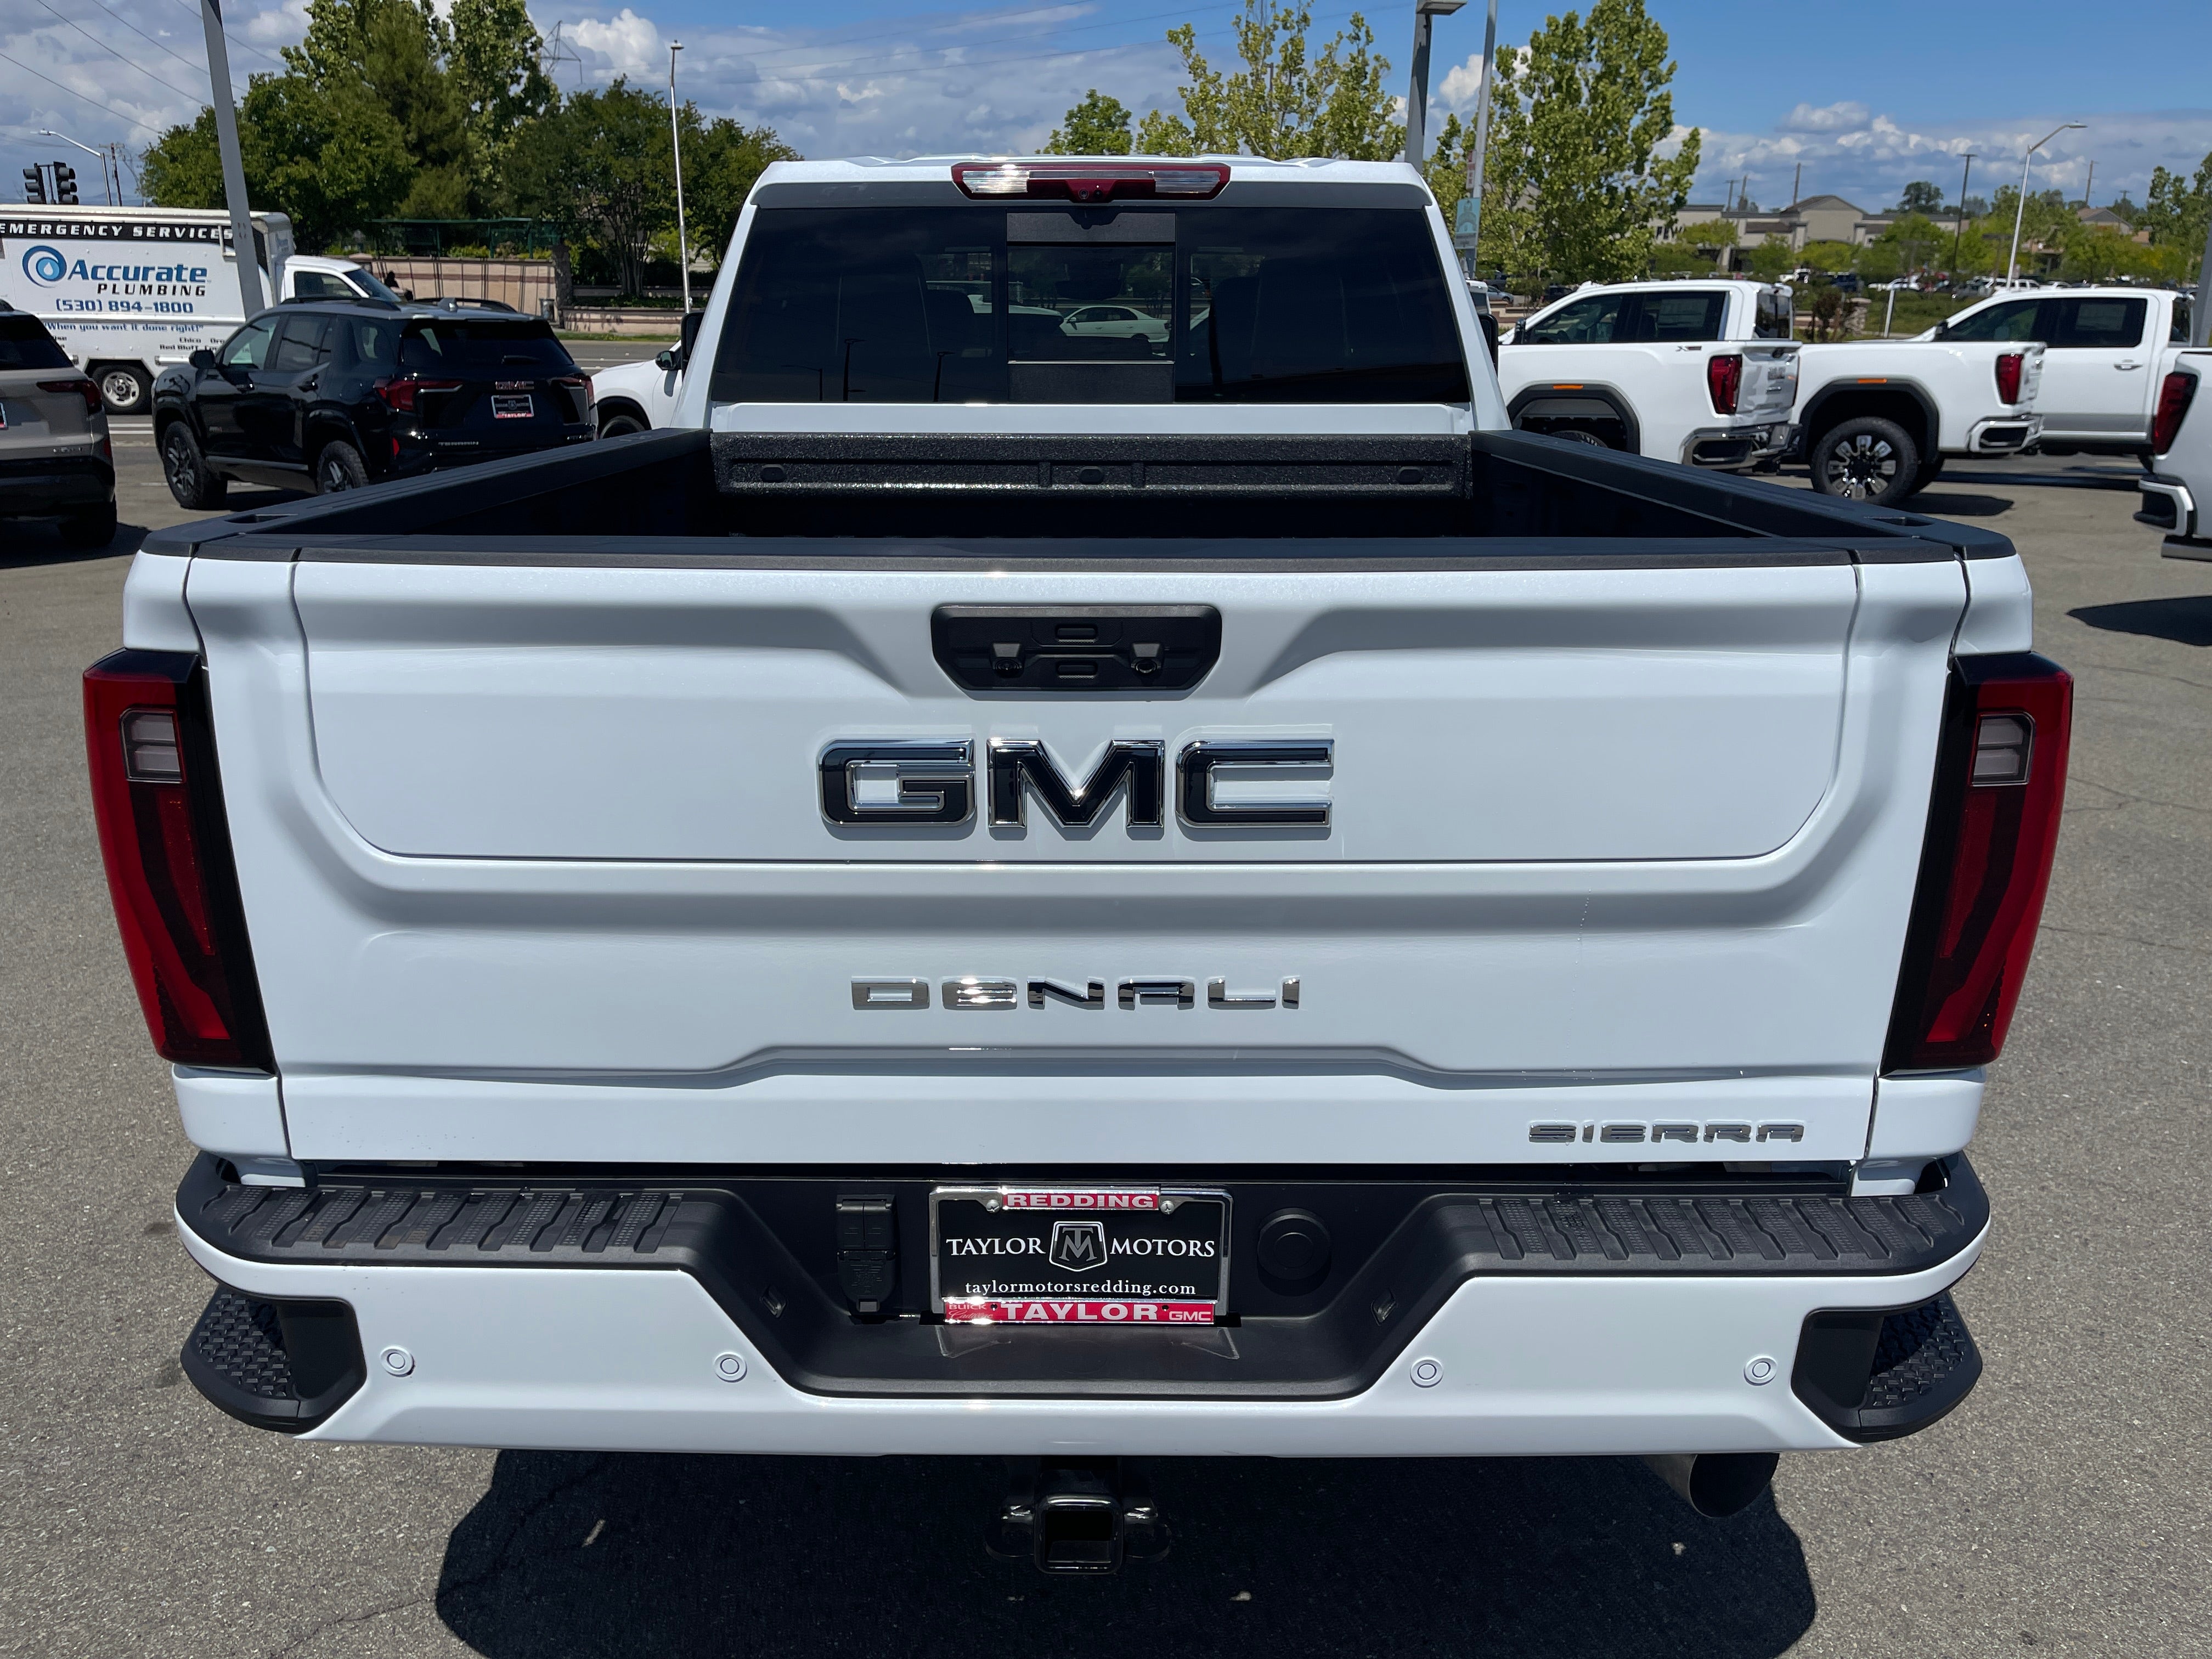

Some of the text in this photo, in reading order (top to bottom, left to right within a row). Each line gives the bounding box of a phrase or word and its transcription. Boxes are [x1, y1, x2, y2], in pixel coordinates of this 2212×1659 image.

[133, 226, 233, 240] SERVICES
[67, 259, 207, 283] Accurate
[97, 283, 205, 297] PLUMBING
[56, 298, 194, 313] (530) 894-1800
[79, 324, 99, 332] you
[102, 323, 128, 331] want
[131, 323, 139, 331] it
[143, 324, 167, 332] done
[495, 380, 534, 390] GMC
[819, 738, 1334, 828] GMC
[851, 976, 1300, 1010] DENALI
[1528, 1124, 1805, 1143] SIERRA
[1007, 1194, 1154, 1208] REDDING
[946, 1238, 1046, 1256] TAYLOR
[1109, 1238, 1215, 1257] MOTORS
[965, 1279, 1197, 1297] taylormotorsredding.com
[1000, 1304, 1158, 1321] TAYLOR
[1169, 1311, 1212, 1321] GMC
